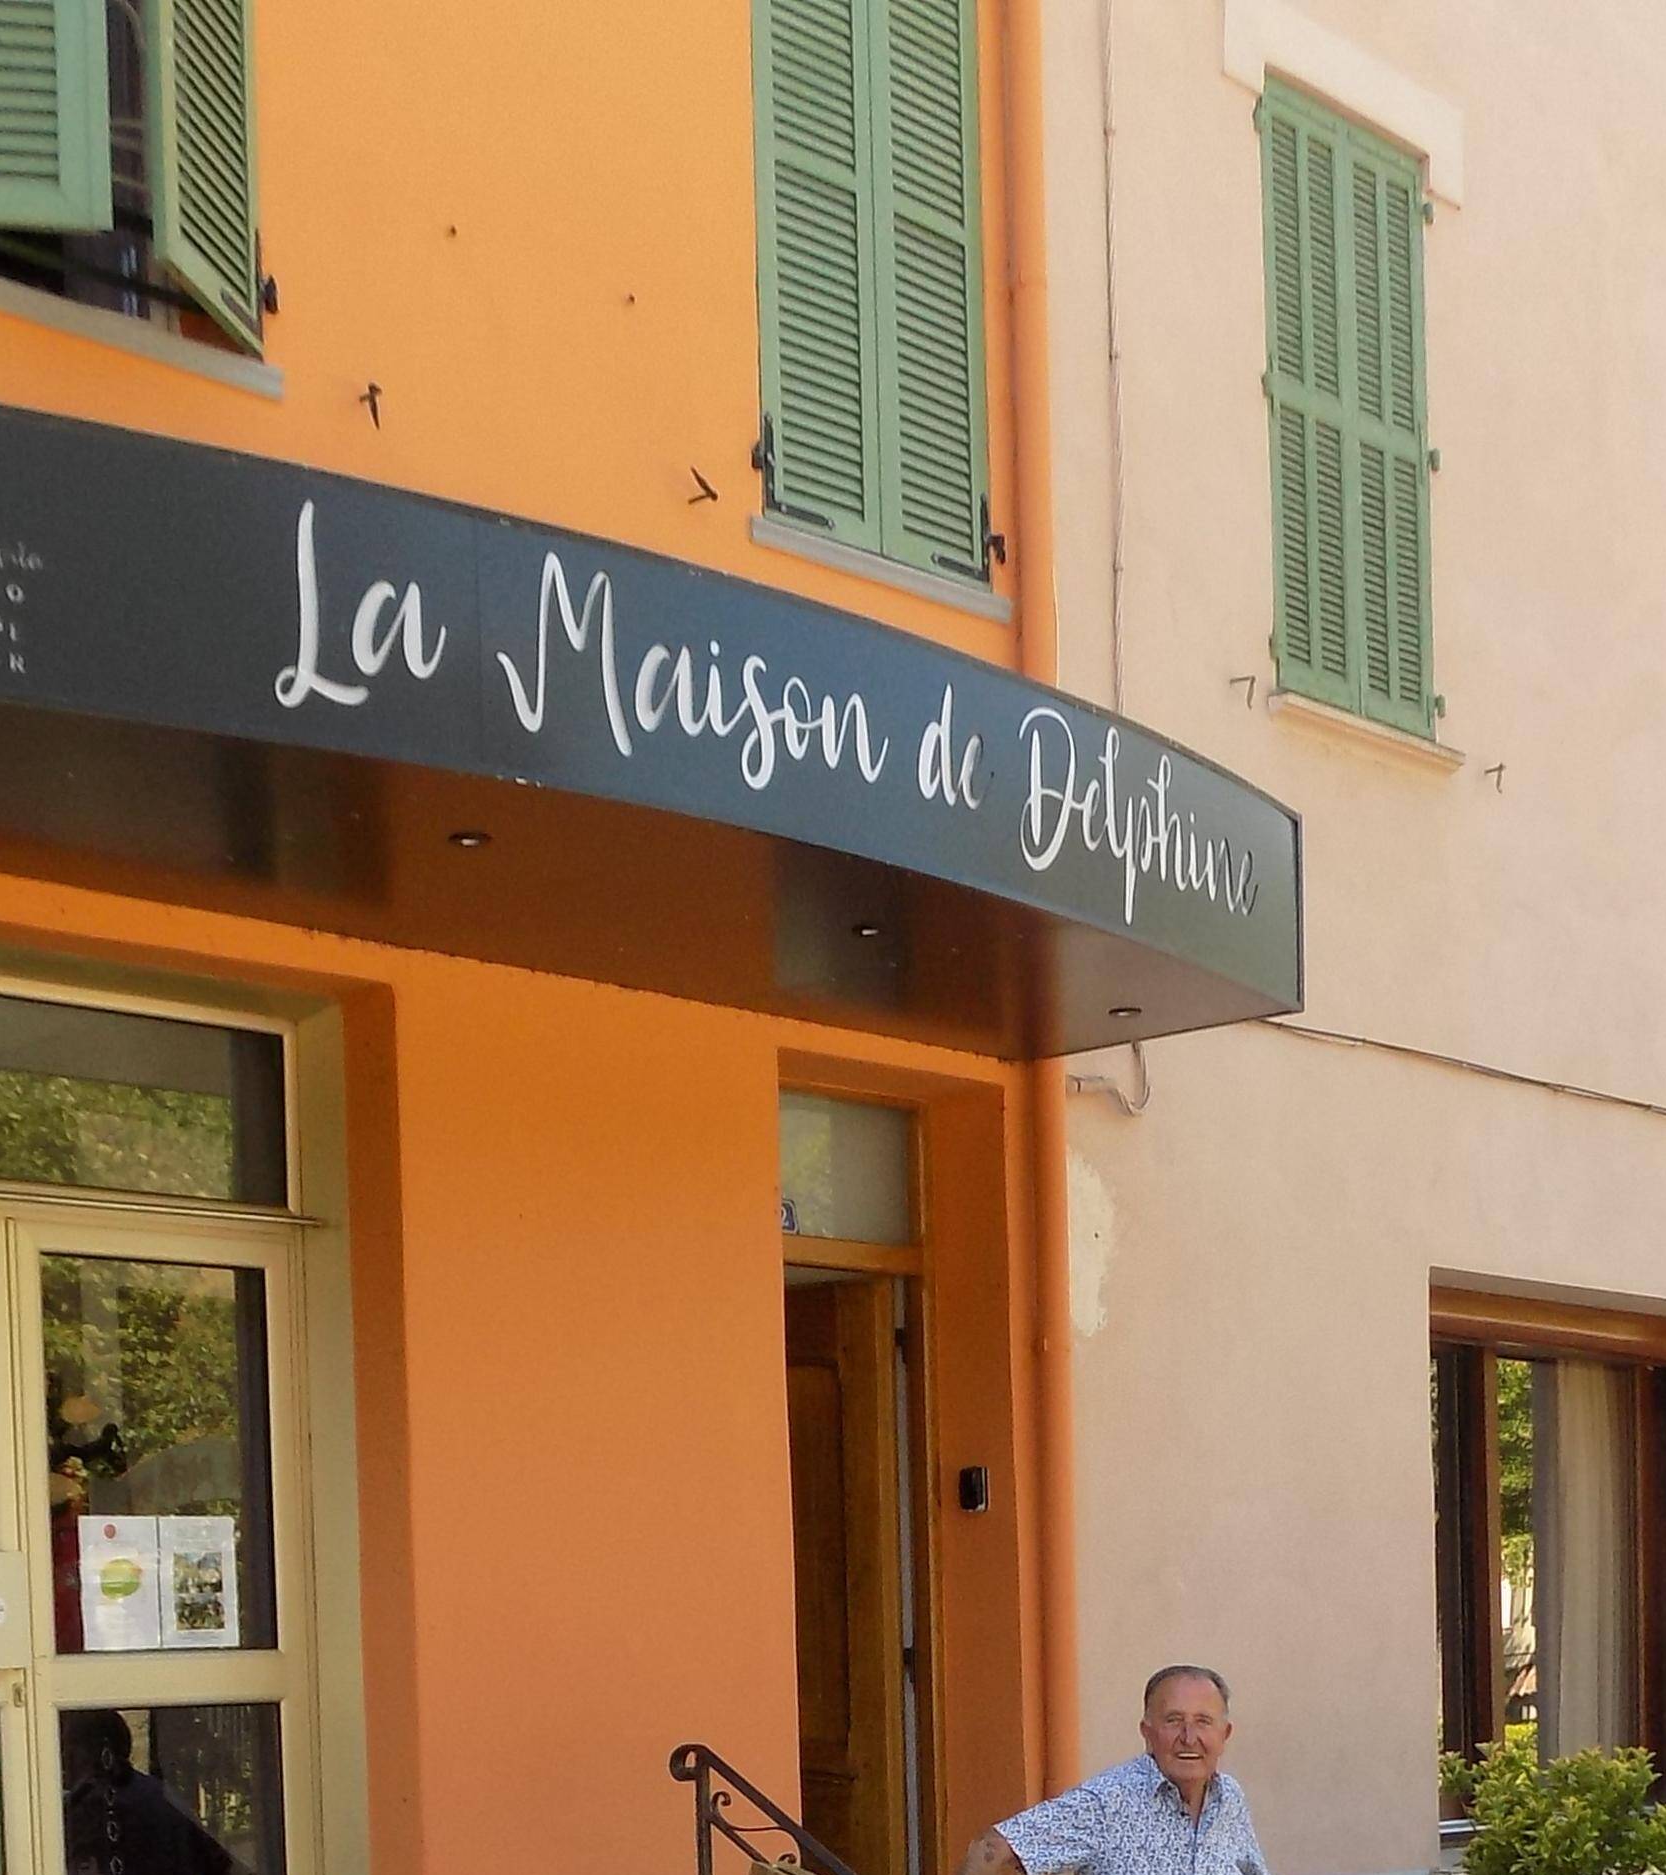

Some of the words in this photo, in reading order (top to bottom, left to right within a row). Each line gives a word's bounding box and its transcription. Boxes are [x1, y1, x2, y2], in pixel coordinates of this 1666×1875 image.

[274, 498, 447, 709] La
[495, 550, 889, 791] Maison
[916, 682, 994, 811] de
[1017, 705, 1260, 926] Delphine
